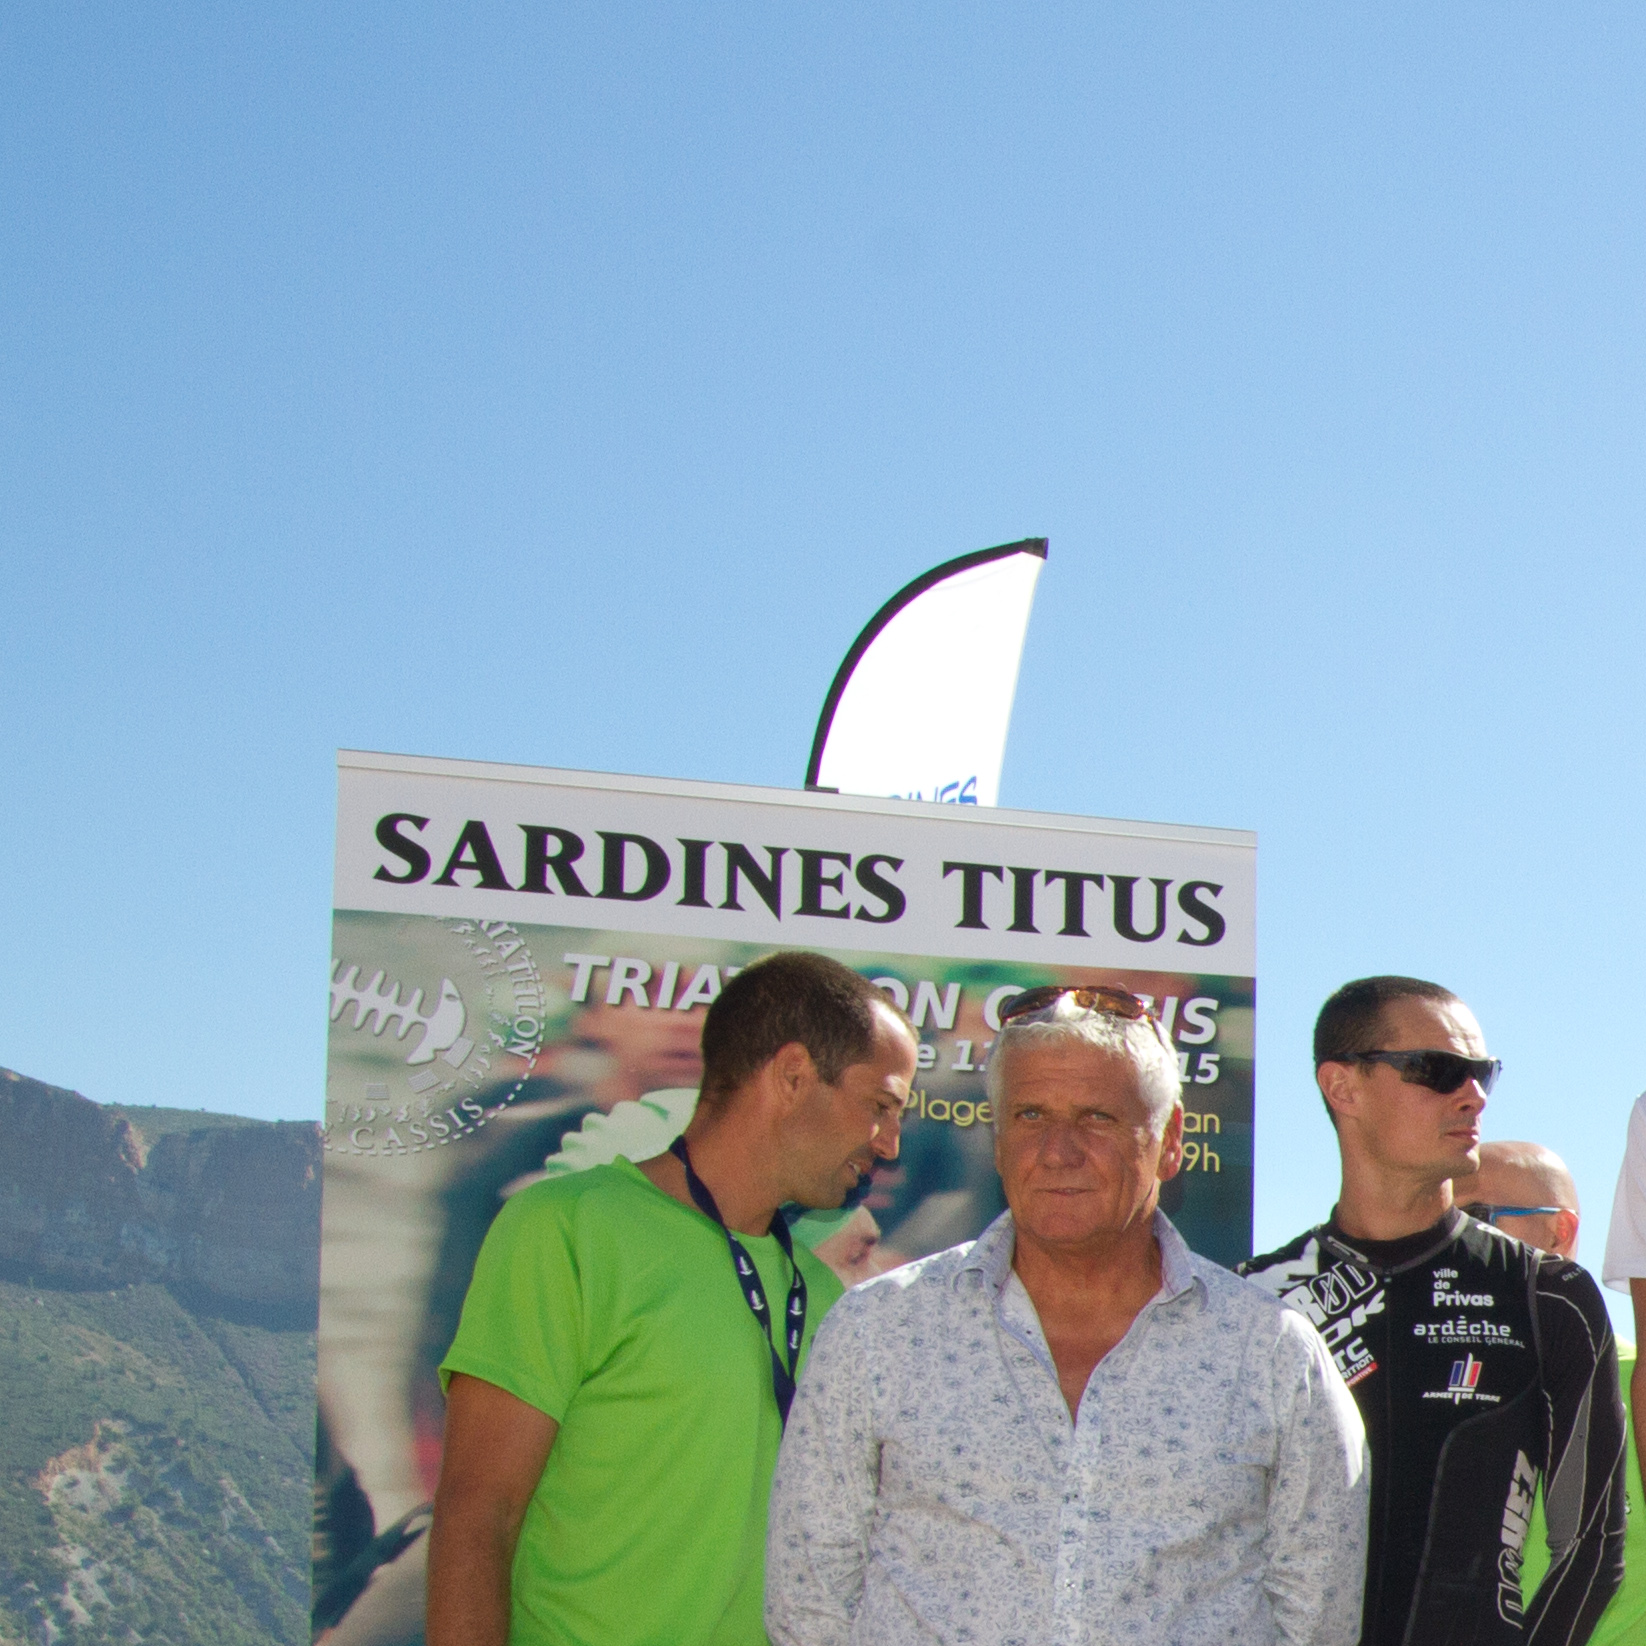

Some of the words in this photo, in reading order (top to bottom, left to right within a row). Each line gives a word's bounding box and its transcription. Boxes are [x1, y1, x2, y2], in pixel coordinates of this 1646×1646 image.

[373, 813, 906, 922] SARDINES
[943, 859, 1228, 947] TITUS
[1432, 1267, 1459, 1280] ville
[1433, 1279, 1451, 1290] de
[1432, 1290, 1495, 1307] Privas
[1461, 1392, 1474, 1400] DE
